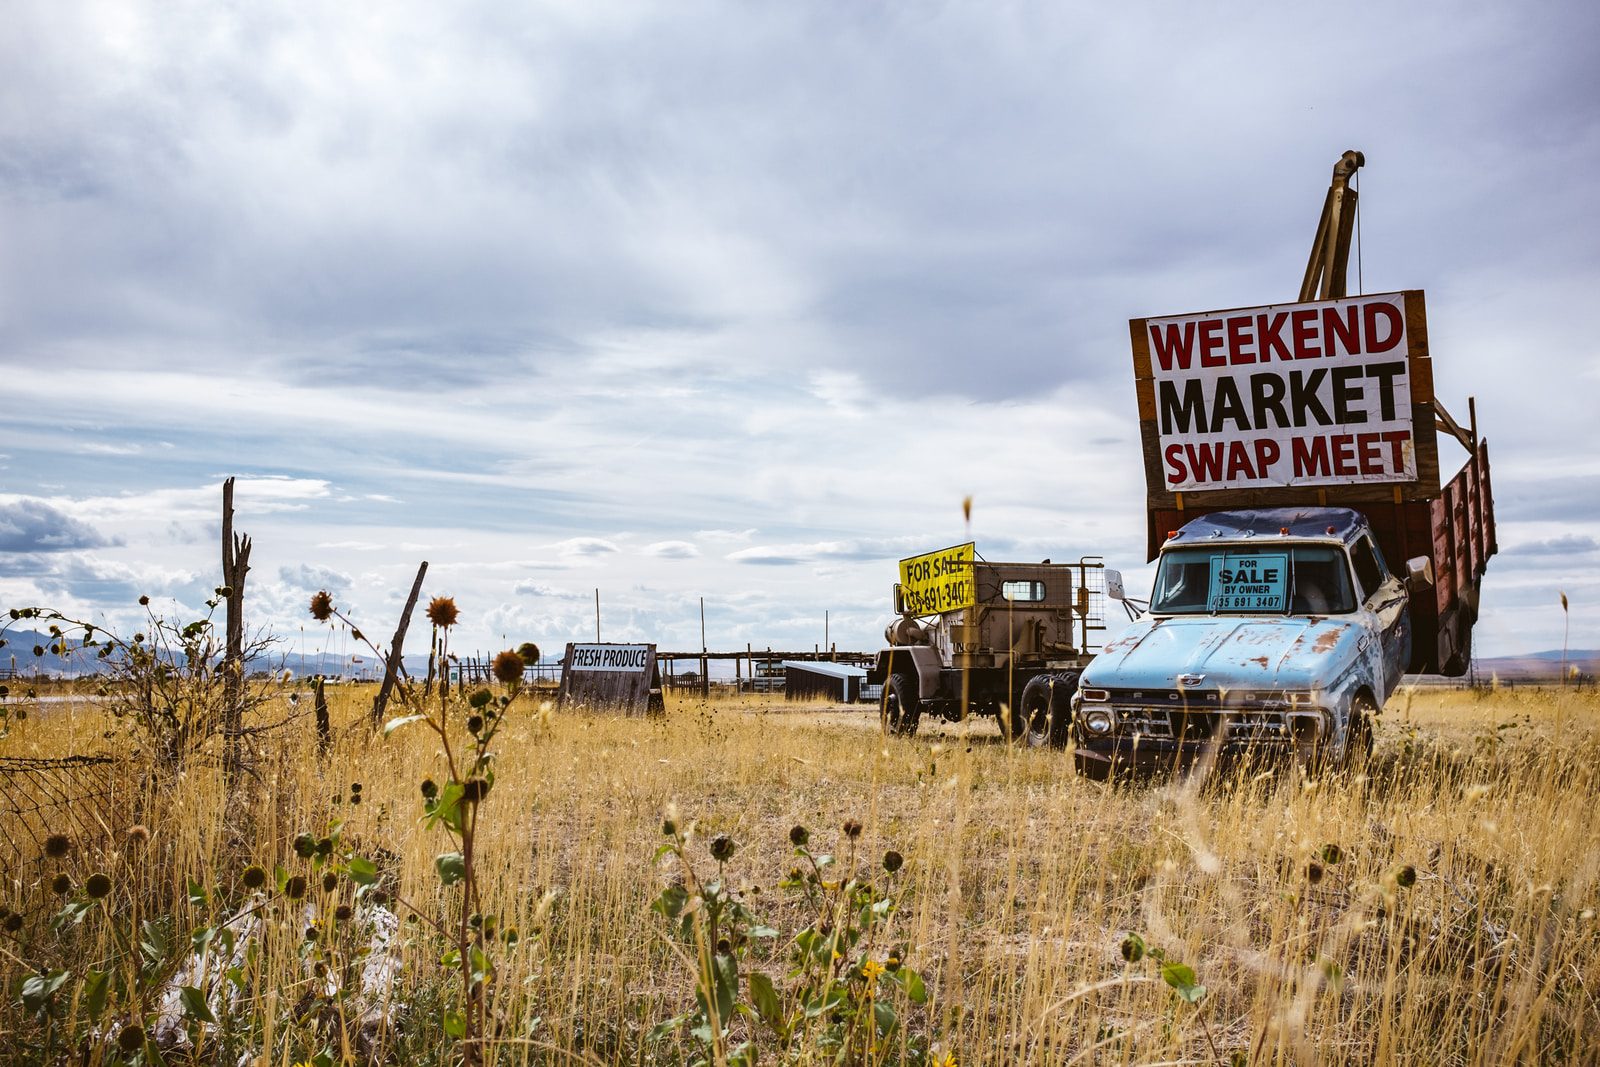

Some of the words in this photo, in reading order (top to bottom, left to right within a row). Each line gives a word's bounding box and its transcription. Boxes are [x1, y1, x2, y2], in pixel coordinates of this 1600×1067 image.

[1150, 302, 1404, 371] WEEKEND
[1159, 361, 1406, 435] MARKET
[1165, 438, 1281, 484] SWAP
[1292, 430, 1411, 478] MEET
[906, 561, 931, 585] FOR
[934, 552, 964, 577] SALE
[1240, 560, 1257, 568] FOR
[1219, 569, 1278, 583] SALE
[1225, 586, 1236, 594] BY
[1239, 585, 1270, 594] OWNER
[1234, 597, 1251, 607] 691
[1257, 597, 1279, 607] 3407
[571, 649, 603, 667] FRESH
[602, 649, 647, 668] PRODUCE
[1133, 692, 1256, 700] FORD
